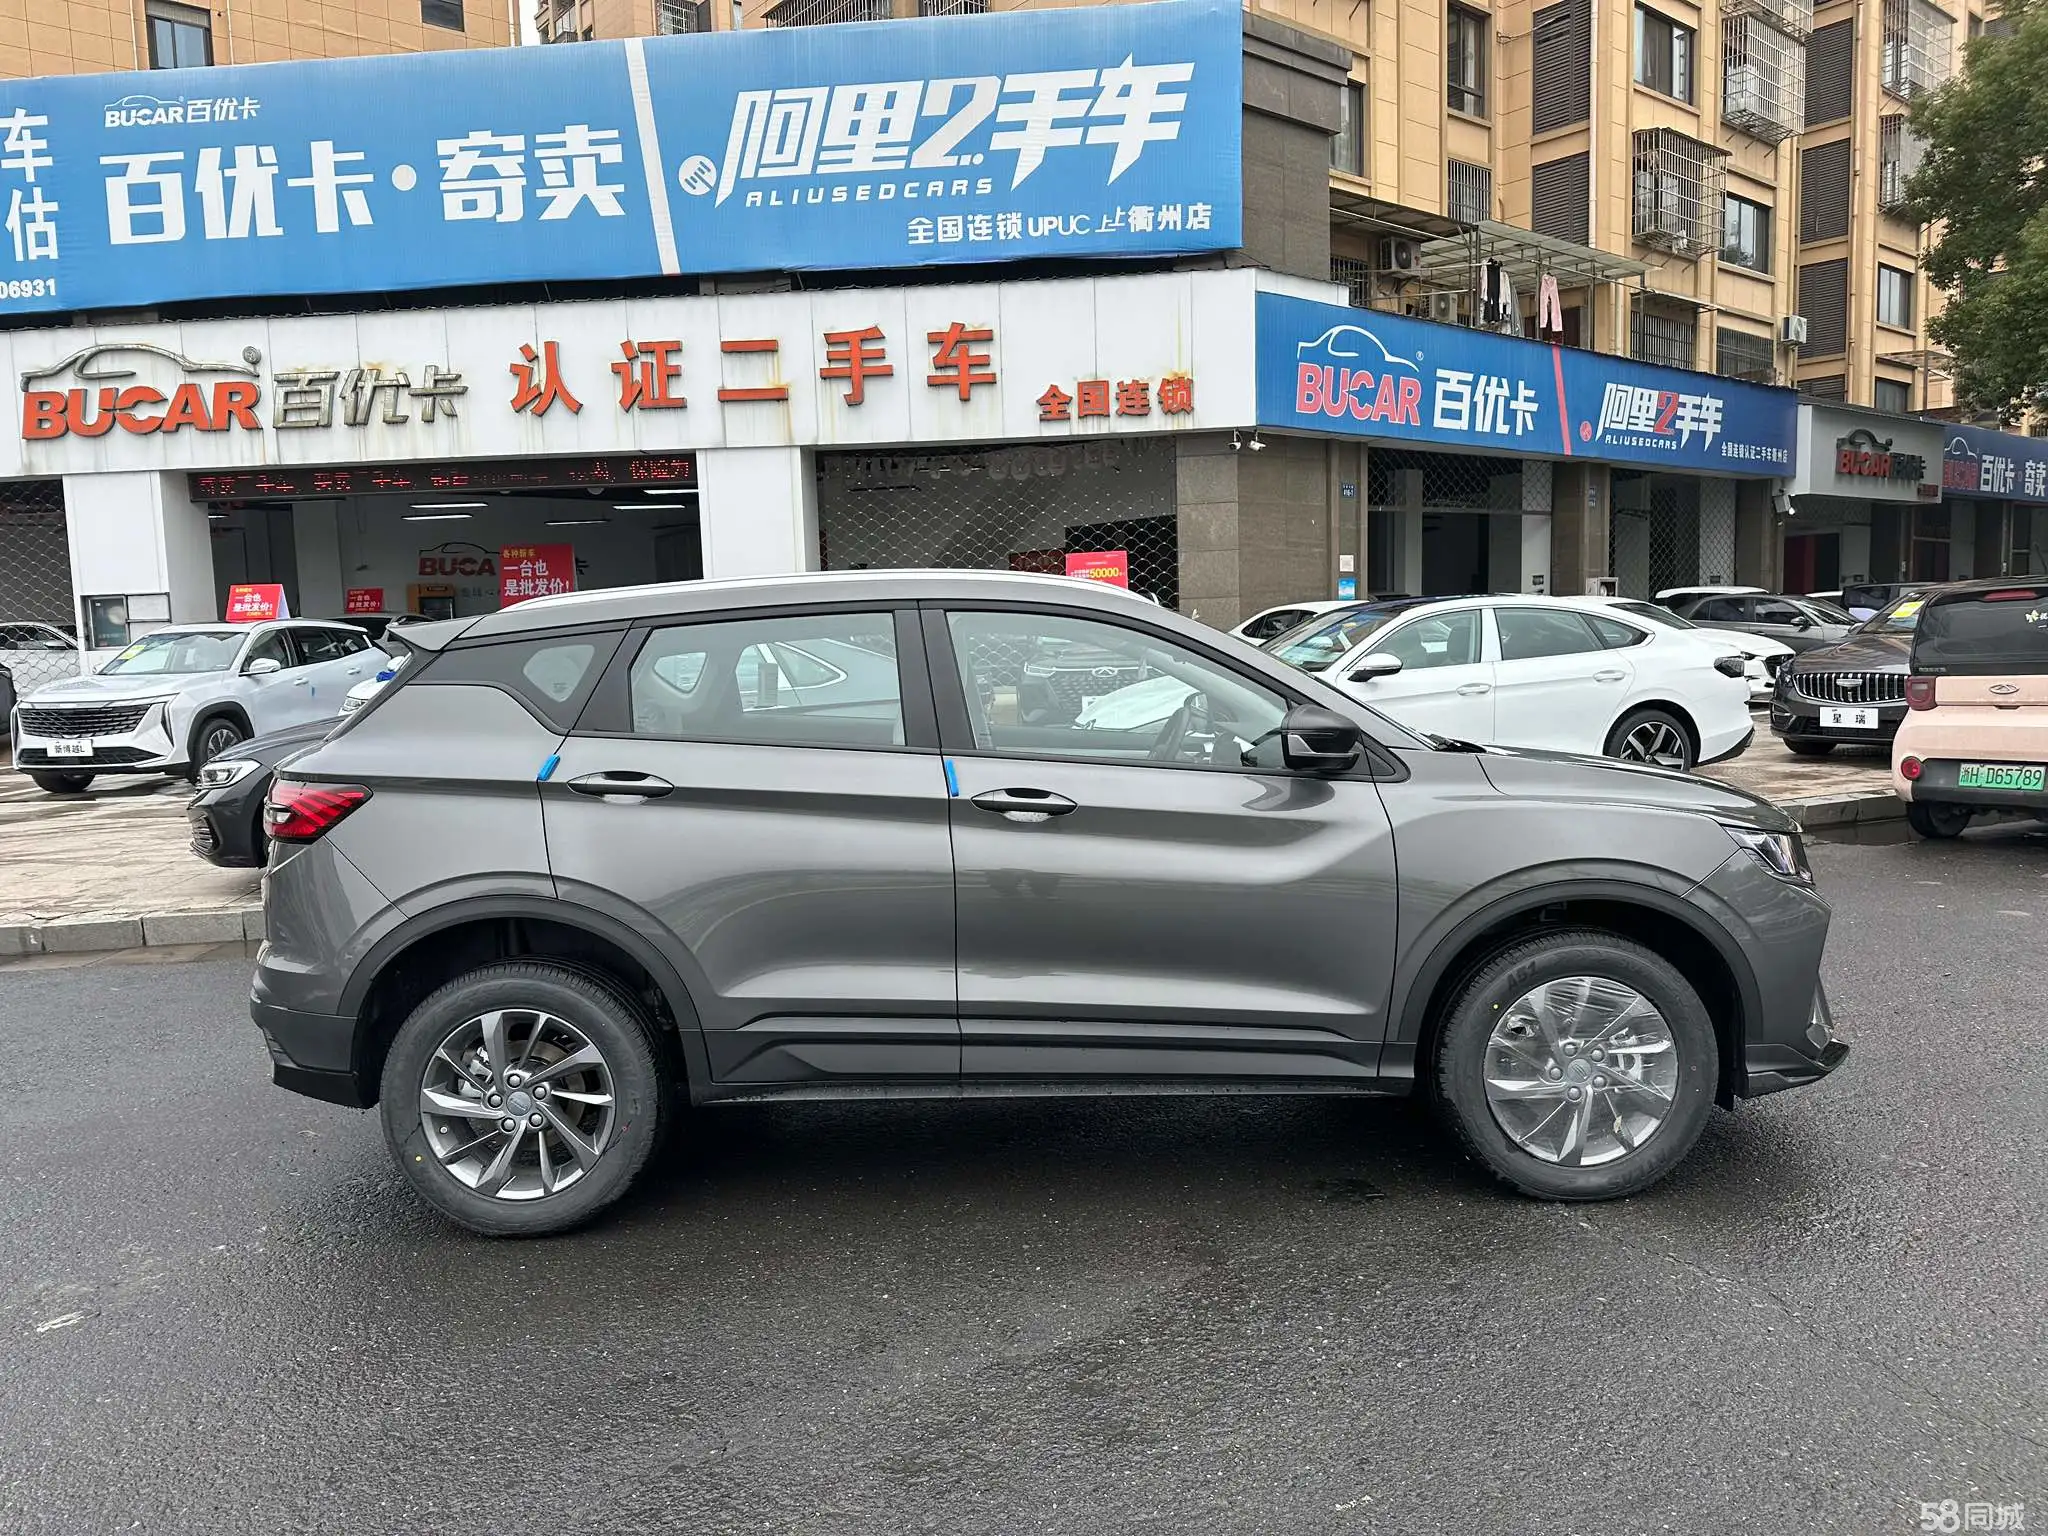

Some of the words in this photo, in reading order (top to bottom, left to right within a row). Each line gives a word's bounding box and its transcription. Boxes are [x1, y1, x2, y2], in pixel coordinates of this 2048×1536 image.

[105, 106, 184, 128] BUCAR
[187, 97, 261, 123] 百优卡
[745, 176, 993, 207] ALIUSEDCARS
[907, 212, 1023, 245] 全国连锁
[1028, 214, 1090, 237] UPUC
[1127, 202, 1212, 233] 衢州店
[509, 321, 997, 417] 认证二手车
[21, 381, 262, 440] BUCAR
[272, 365, 469, 430] 百优卡
[1037, 376, 1195, 422] 全国连锁
[1295, 362, 1422, 426] BUCAR
[1433, 368, 1539, 436] 百优卡
[1604, 434, 1677, 450] ALIUSEDCARS
[419, 557, 497, 577] BUCA
[503, 560, 549, 577] 一台也
[1088, 567, 1119, 578] 50000
[1985, 767, 2042, 787] D65789
